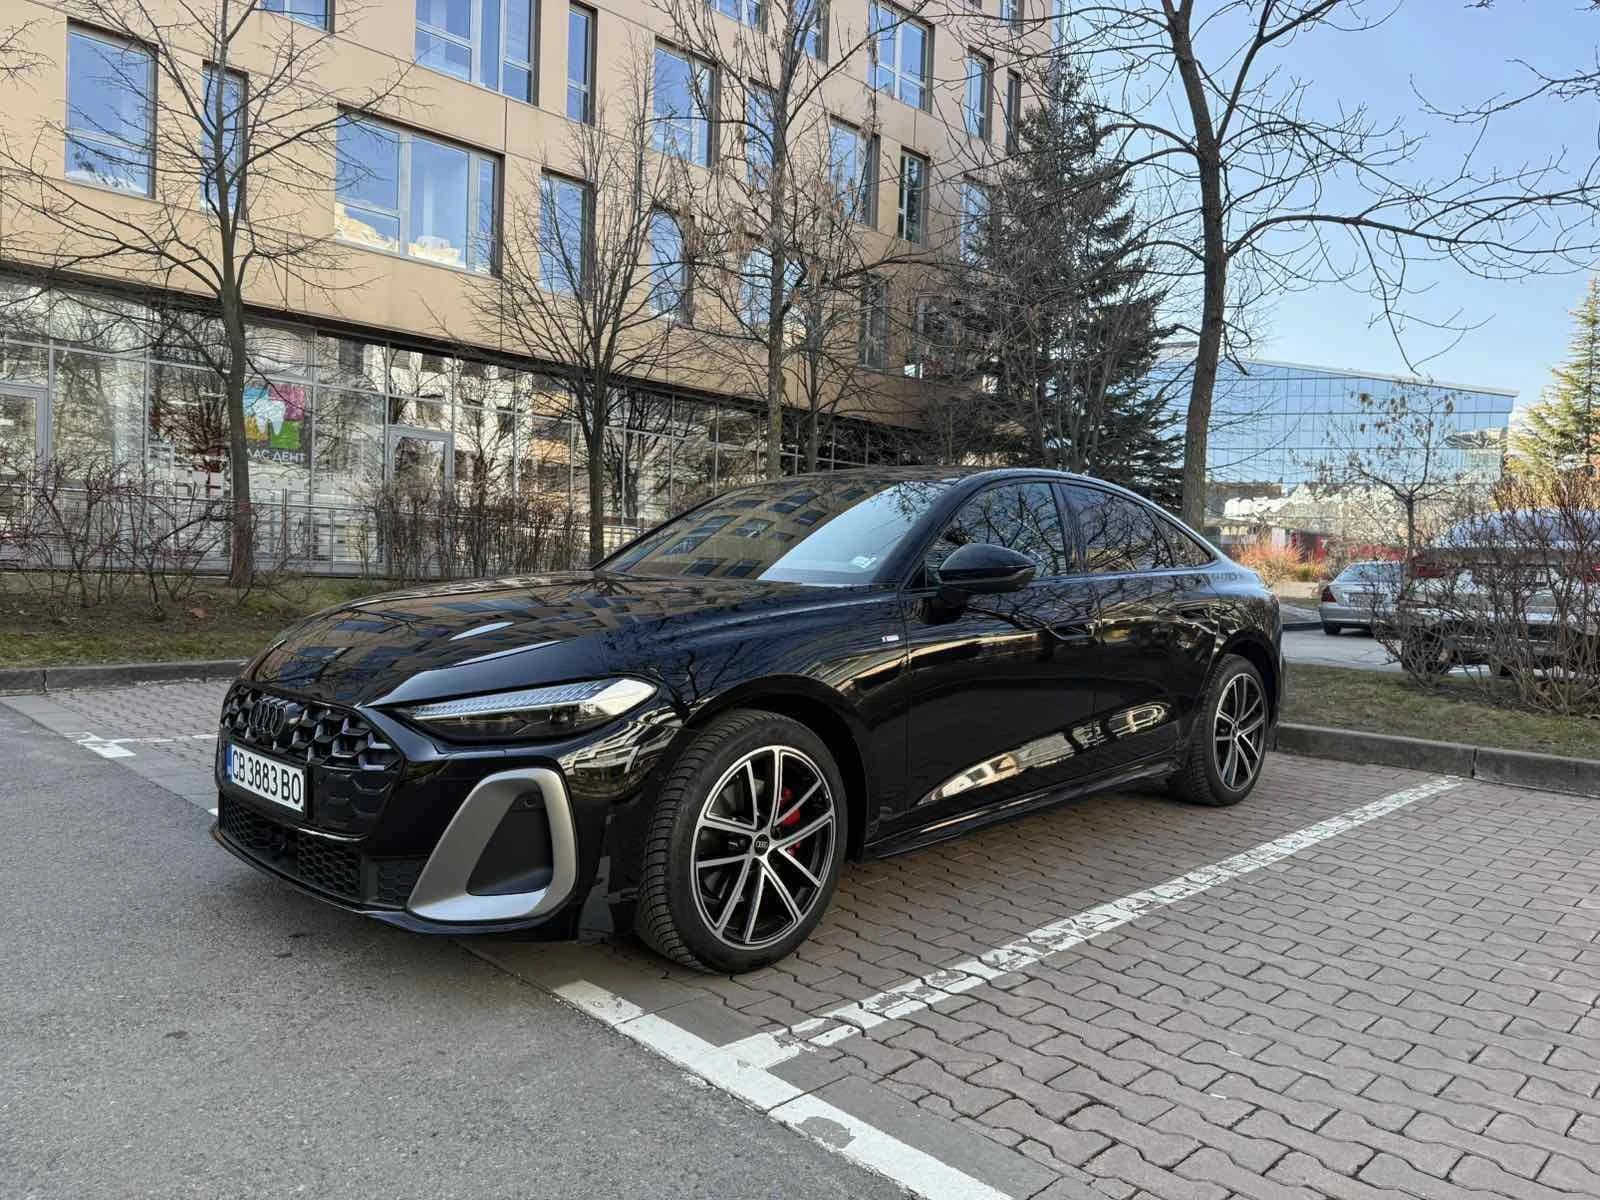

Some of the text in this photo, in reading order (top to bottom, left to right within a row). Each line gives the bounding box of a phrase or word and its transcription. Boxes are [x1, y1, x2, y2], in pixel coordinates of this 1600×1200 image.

[233, 750, 301, 804] CB 3883 BO
